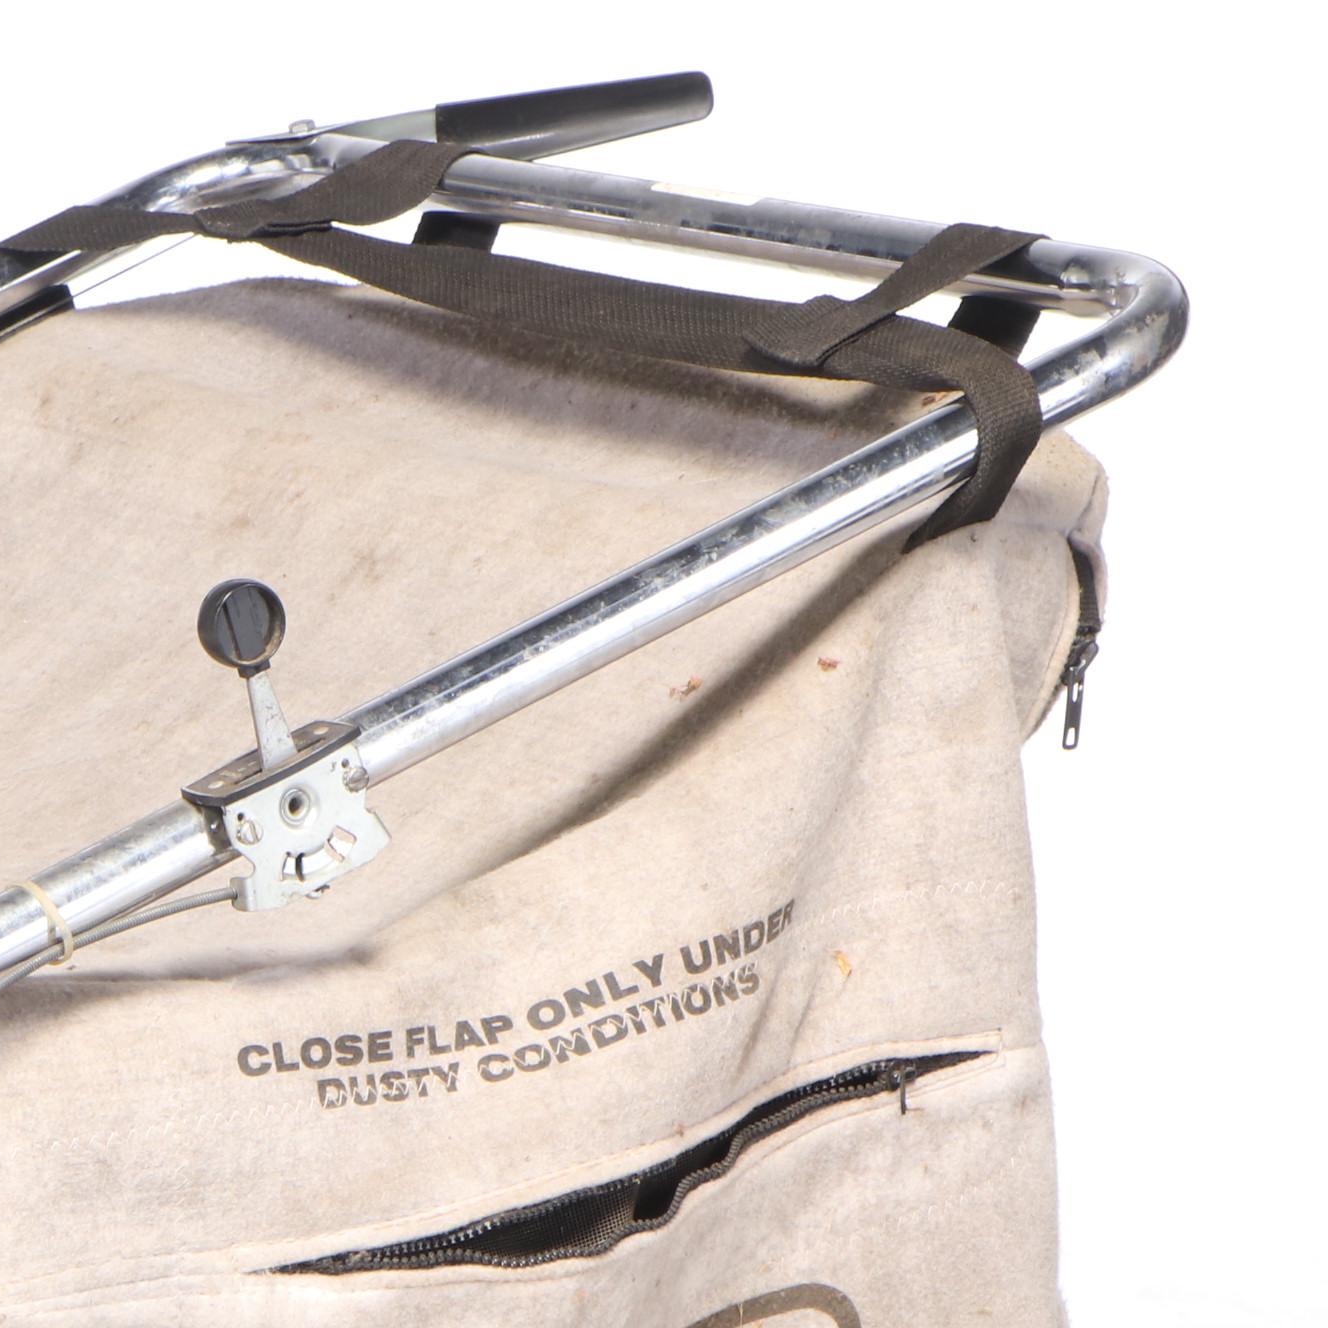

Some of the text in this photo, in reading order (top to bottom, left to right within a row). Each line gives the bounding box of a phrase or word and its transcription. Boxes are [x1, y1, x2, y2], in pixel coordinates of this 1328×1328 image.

[238, 900, 794, 1076] CLOSE FLAP ONLY UNDER
[318, 963, 760, 1109] DUSTY CONDITIONS
